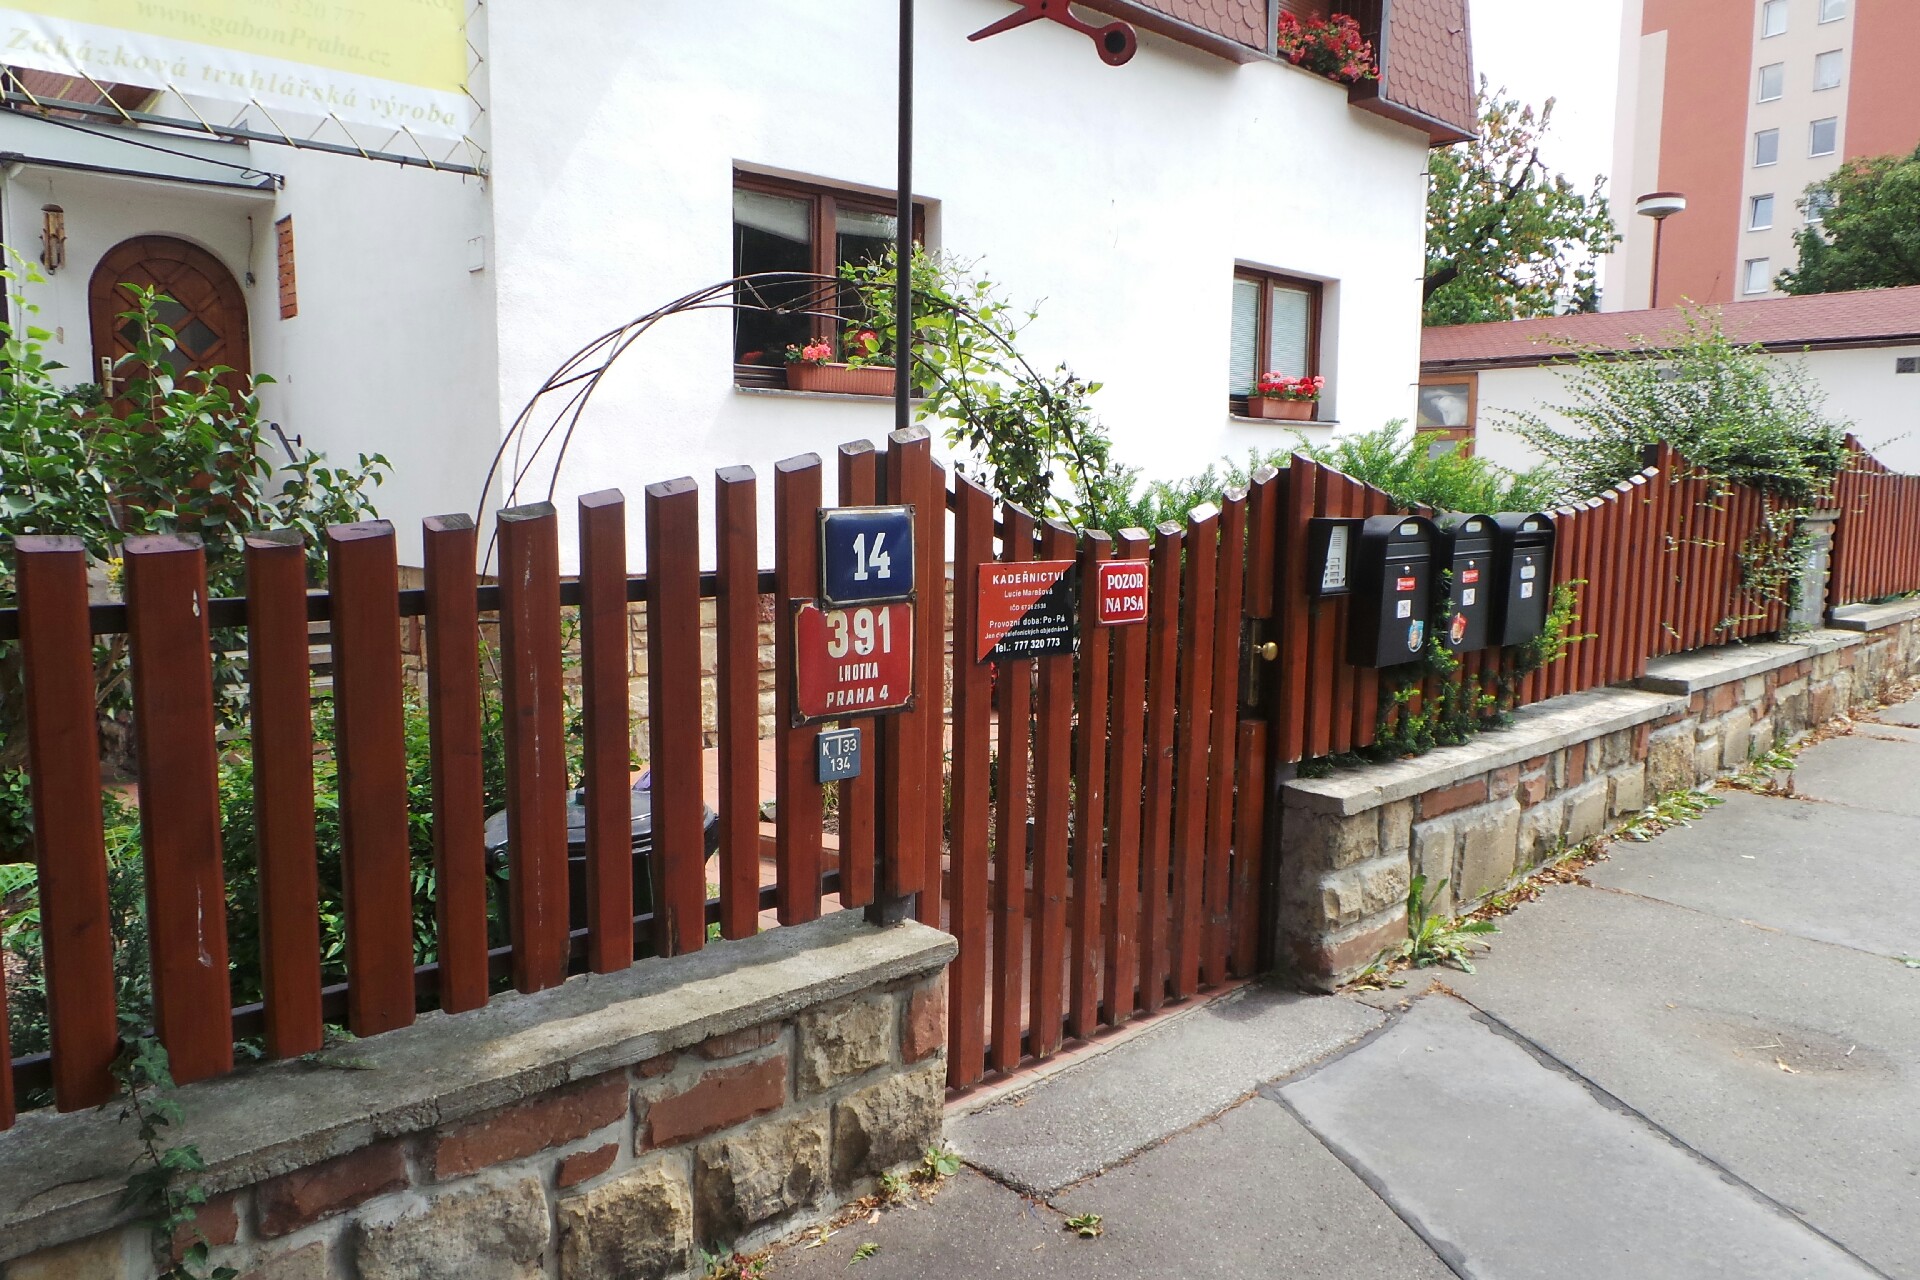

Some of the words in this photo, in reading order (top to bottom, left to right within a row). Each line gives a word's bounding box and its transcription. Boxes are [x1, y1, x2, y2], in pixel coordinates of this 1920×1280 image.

[137, 1, 391, 67] www.gabonPraha.cz
[6, 27, 188, 78] Zakázková
[201, 63, 357, 109] truhlářská
[370, 95, 456, 127] výroba
[852, 532, 891, 581] 14
[992, 570, 1064, 585] KADEŘNICTVÍ
[1107, 573, 1144, 590] POZOR
[1004, 589, 1022, 598] Lucie
[1105, 597, 1121, 613] NA
[1123, 595, 1144, 611] PSA
[989, 618, 1020, 628] Provozní
[1023, 617, 1042, 626] doba:
[826, 606, 891, 659] 391
[994, 642, 1011, 653] Tel.:
[1014, 640, 1029, 651] 777
[1030, 638, 1045, 649] 320
[1046, 637, 1061, 647] 773
[838, 661, 879, 683] LHOTKA
[826, 687, 875, 709] PRAHA
[879, 684, 889, 701] 4
[842, 737, 857, 753] 33
[830, 756, 851, 772] 134
